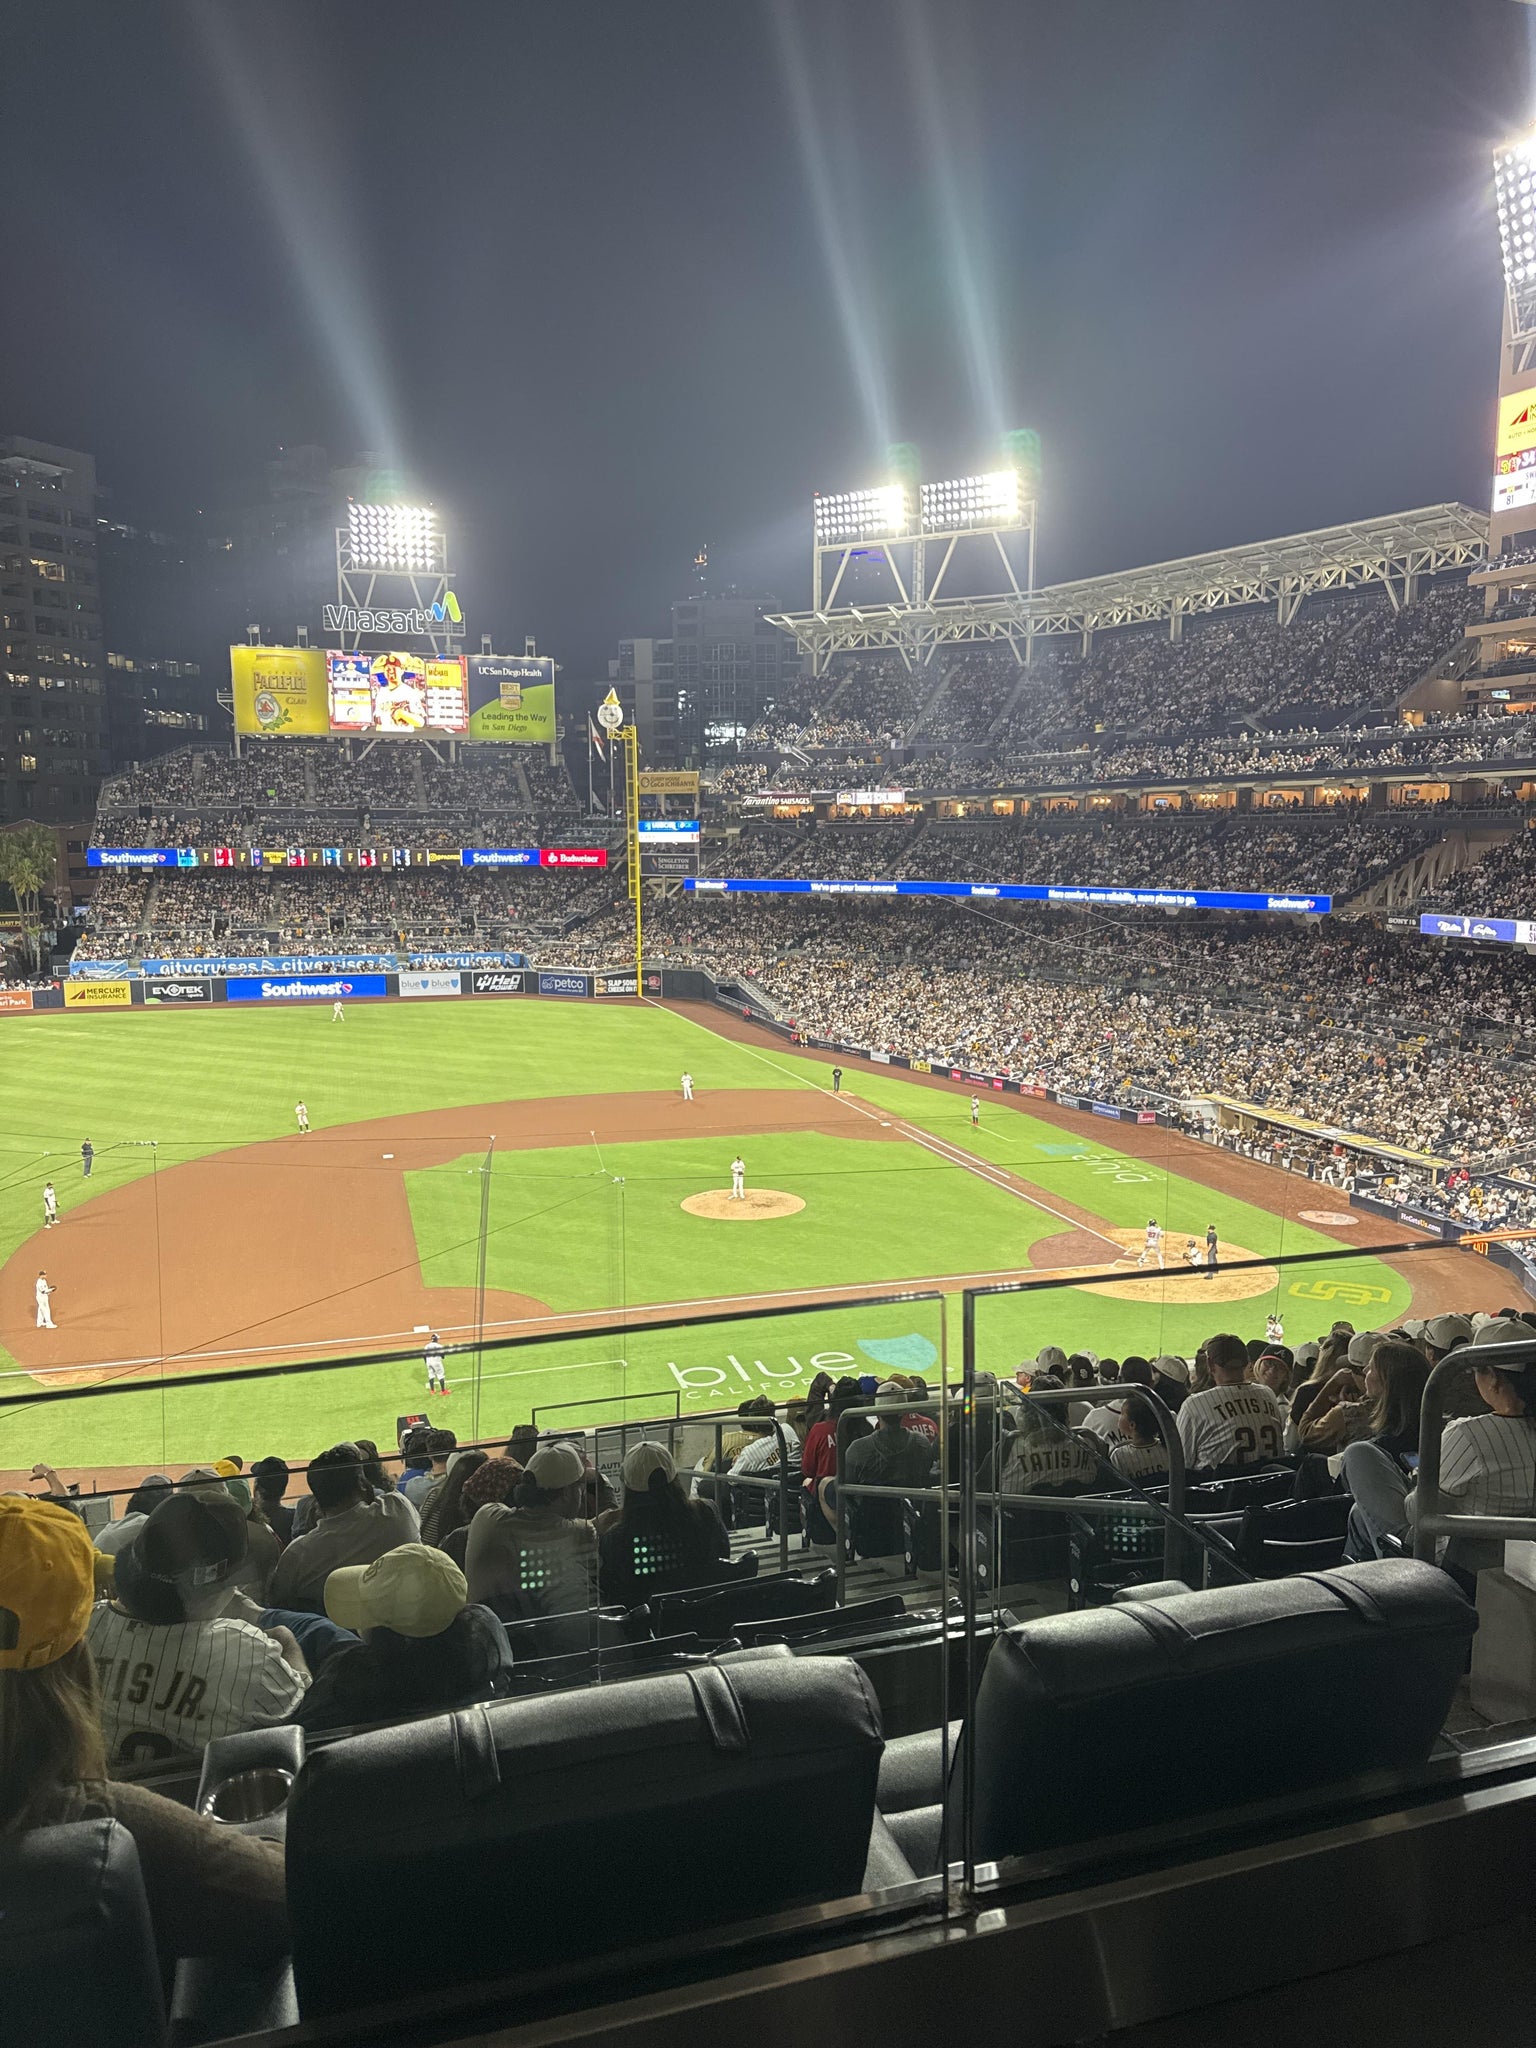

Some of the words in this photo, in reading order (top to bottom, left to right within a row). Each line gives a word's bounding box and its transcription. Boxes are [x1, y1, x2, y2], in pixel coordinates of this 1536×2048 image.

[326, 604, 424, 634] Viasat
[481, 712, 515, 722] Leading
[515, 713, 529, 721] the
[529, 714, 547, 723] Way
[100, 852, 159, 864] Southwest
[473, 852, 523, 863] Southwest
[560, 853, 599, 863] Budweiser
[261, 981, 343, 997] Southwest
[401, 979, 421, 988] blue
[431, 978, 451, 987] blue
[554, 978, 584, 990] petco
[86, 987, 126, 995] MERCURY
[667, 1351, 858, 1389] blue
[1214, 1398, 1260, 1420] TATIS
[1234, 1424, 1279, 1465] 23
[1017, 1451, 1071, 1474] TATIS
[154, 1670, 206, 1721] JR.
